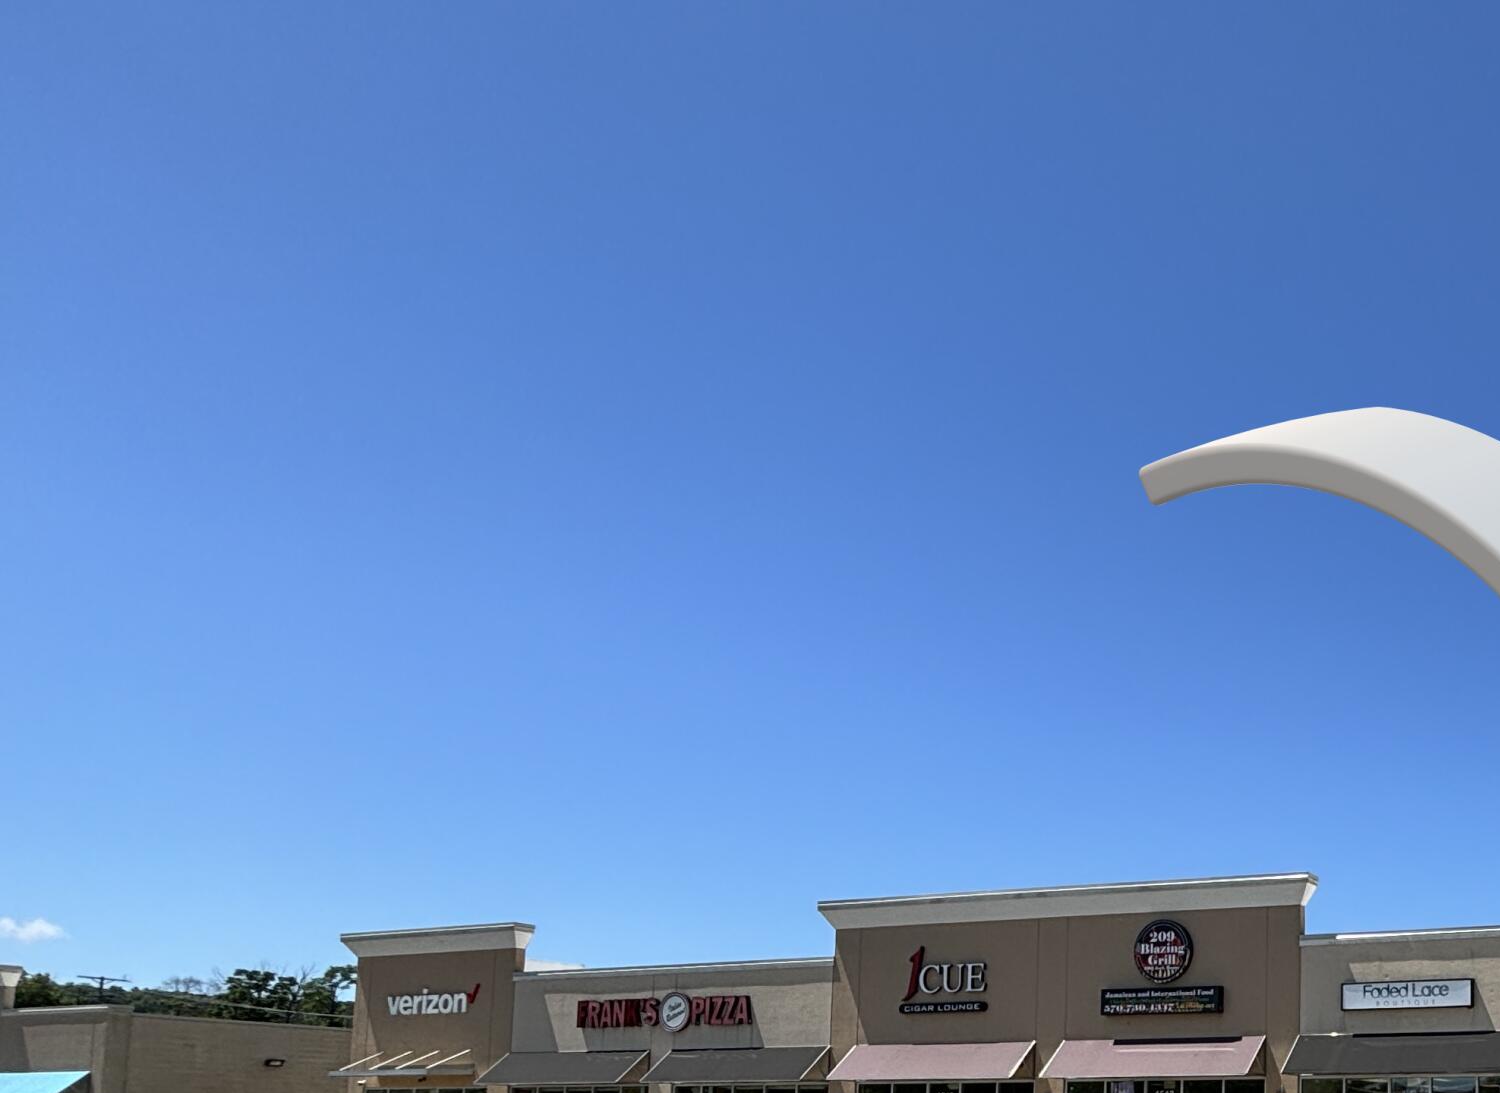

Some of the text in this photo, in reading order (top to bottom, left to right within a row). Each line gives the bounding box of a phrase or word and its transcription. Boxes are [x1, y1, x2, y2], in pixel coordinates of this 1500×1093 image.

[1149, 931, 1175, 942] 209
[1140, 943, 1185, 954] Blazing
[1147, 954, 1176, 965] Grill
[1363, 983, 1449, 998] Faded Lace
[387, 988, 467, 1015] verizon
[577, 998, 660, 1027] FRANK'S
[938, 1003, 980, 1012] LOUNGE
